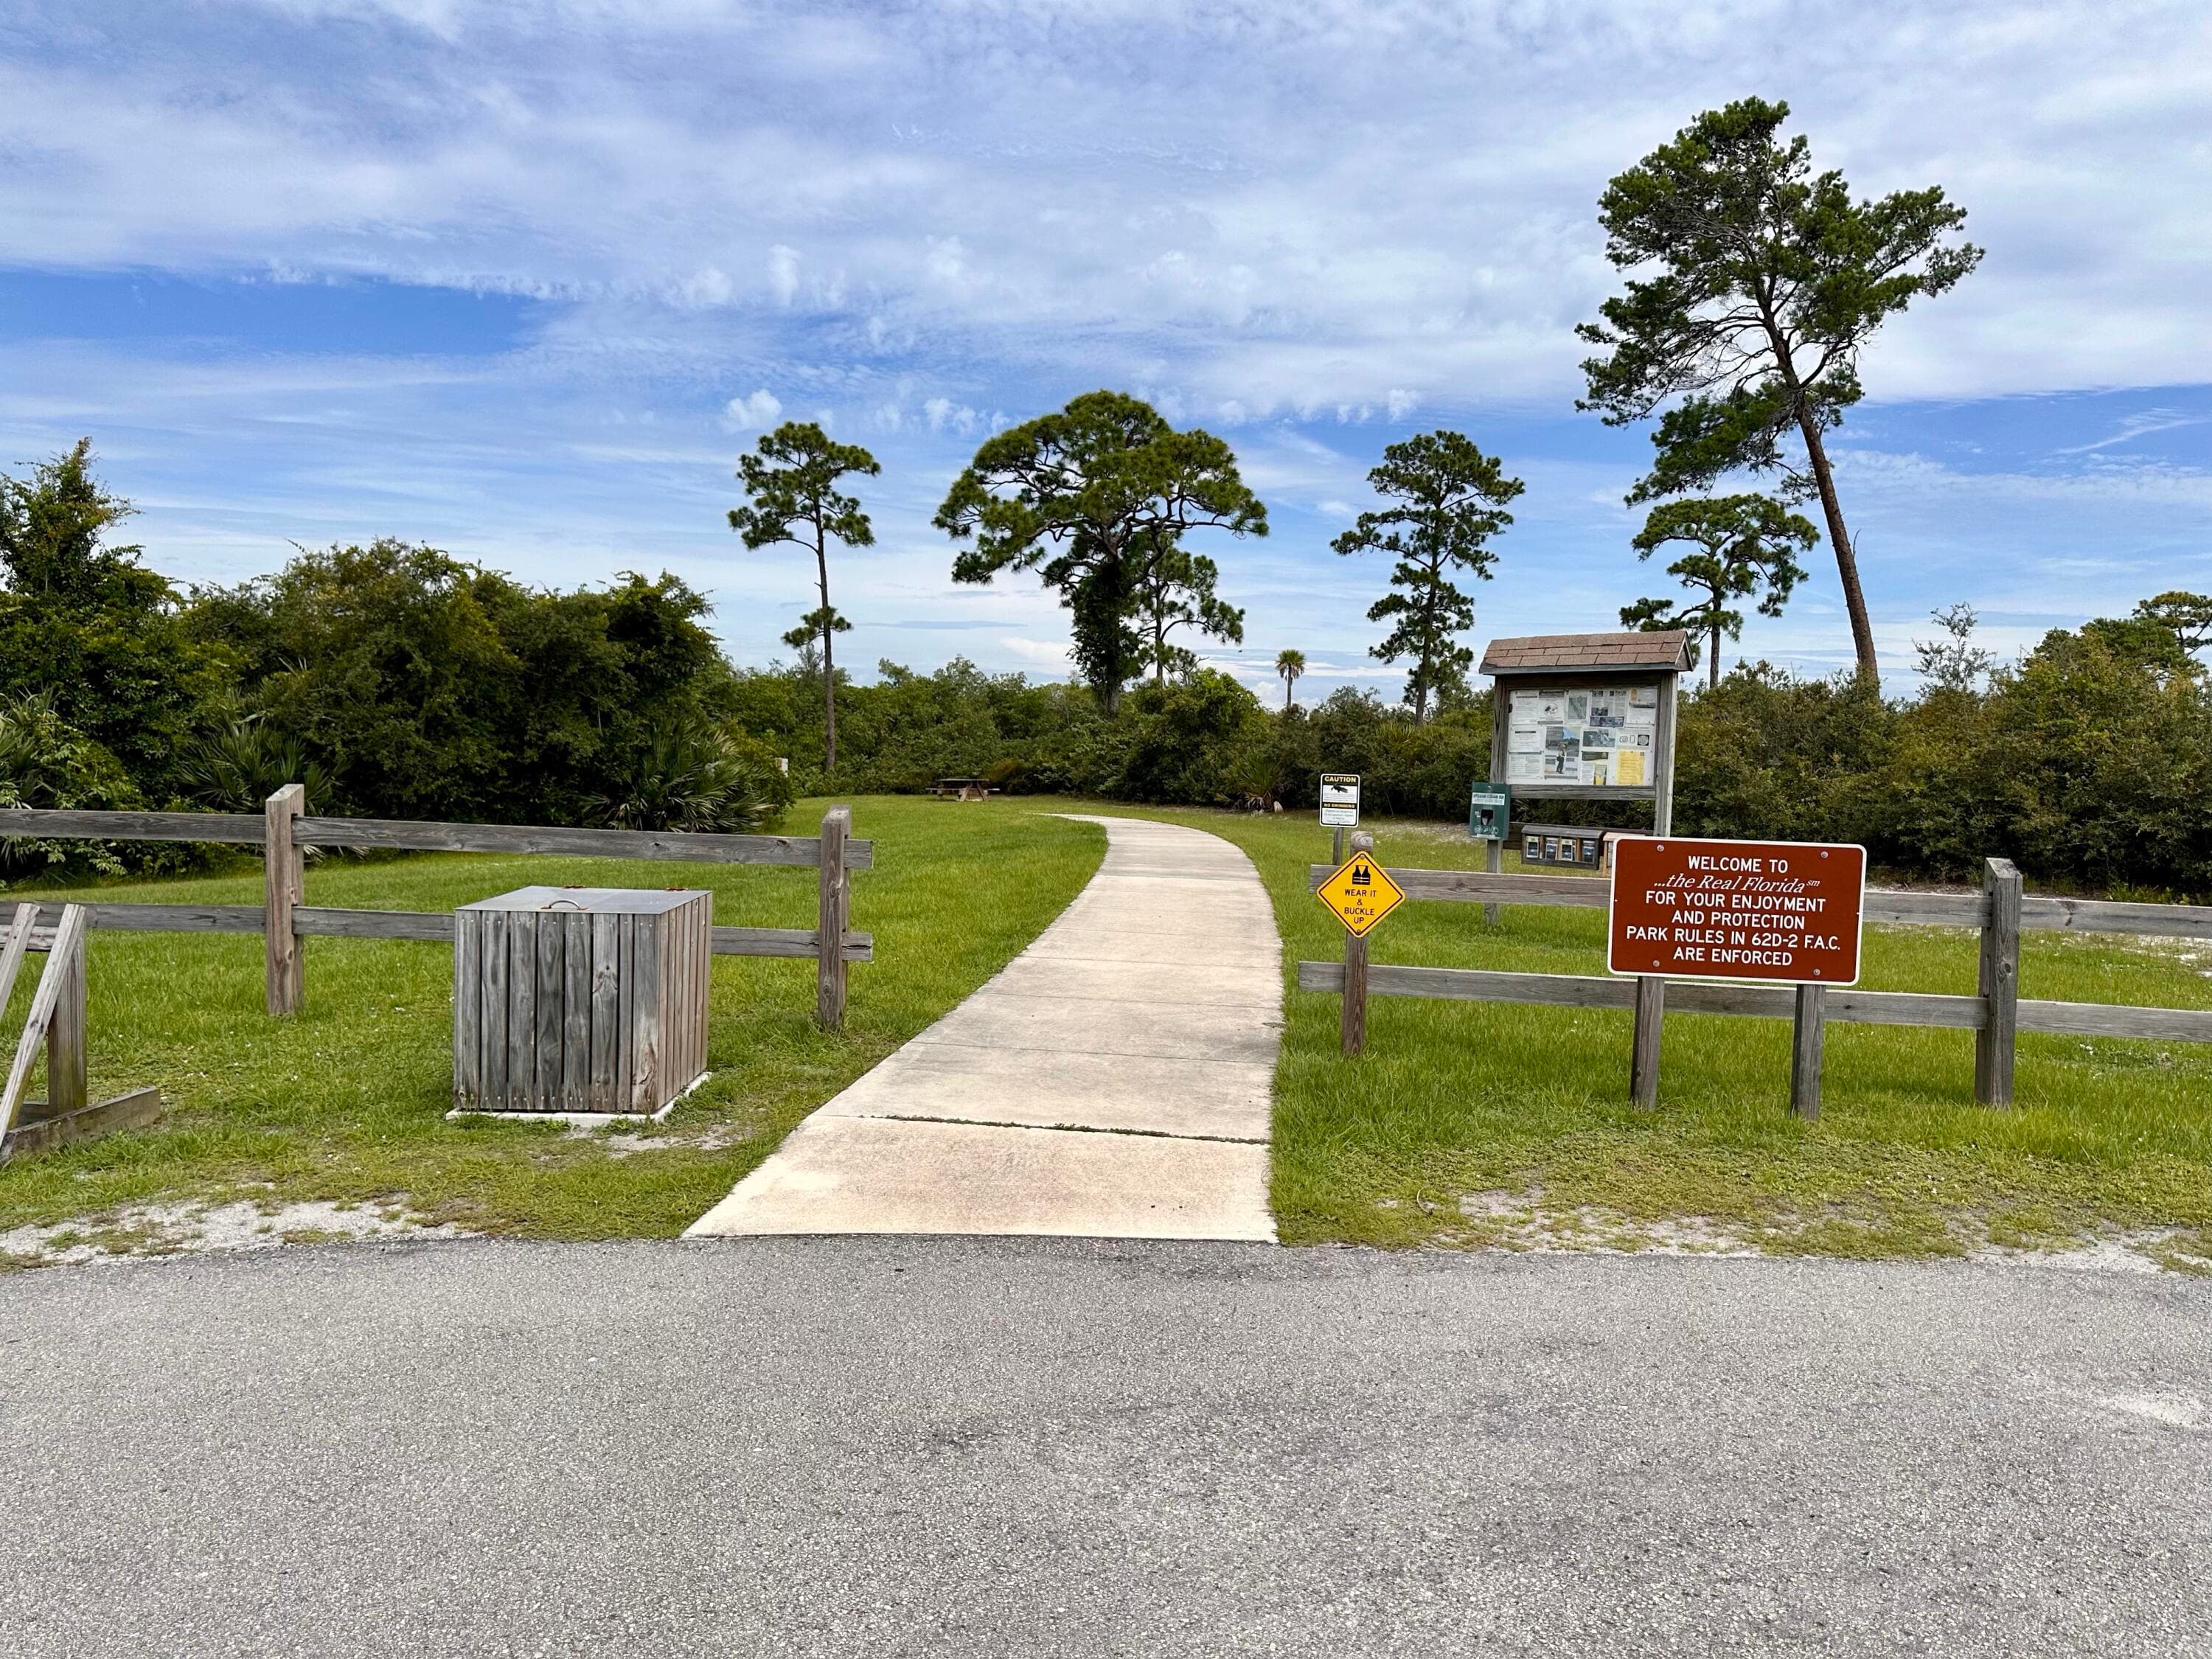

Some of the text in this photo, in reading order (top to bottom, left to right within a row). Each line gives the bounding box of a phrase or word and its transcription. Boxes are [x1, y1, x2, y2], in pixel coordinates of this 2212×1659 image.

[1688, 855, 1789, 874] WELCOME TO
[1344, 888, 1367, 897] WEAR
[1696, 874, 1743, 890] Real
[1740, 876, 1806, 894] Florida
[1357, 898, 1363, 906] &
[1646, 890, 1826, 912] FOR YOUR ENJOYMENT
[1344, 907, 1374, 916] BUCKLE
[1671, 909, 1805, 930] AND PROTECTION
[1627, 925, 1841, 950] PARK RULES IN 62D-2 F.A.C.
[1673, 946, 1792, 966] ARE ENFORCED
